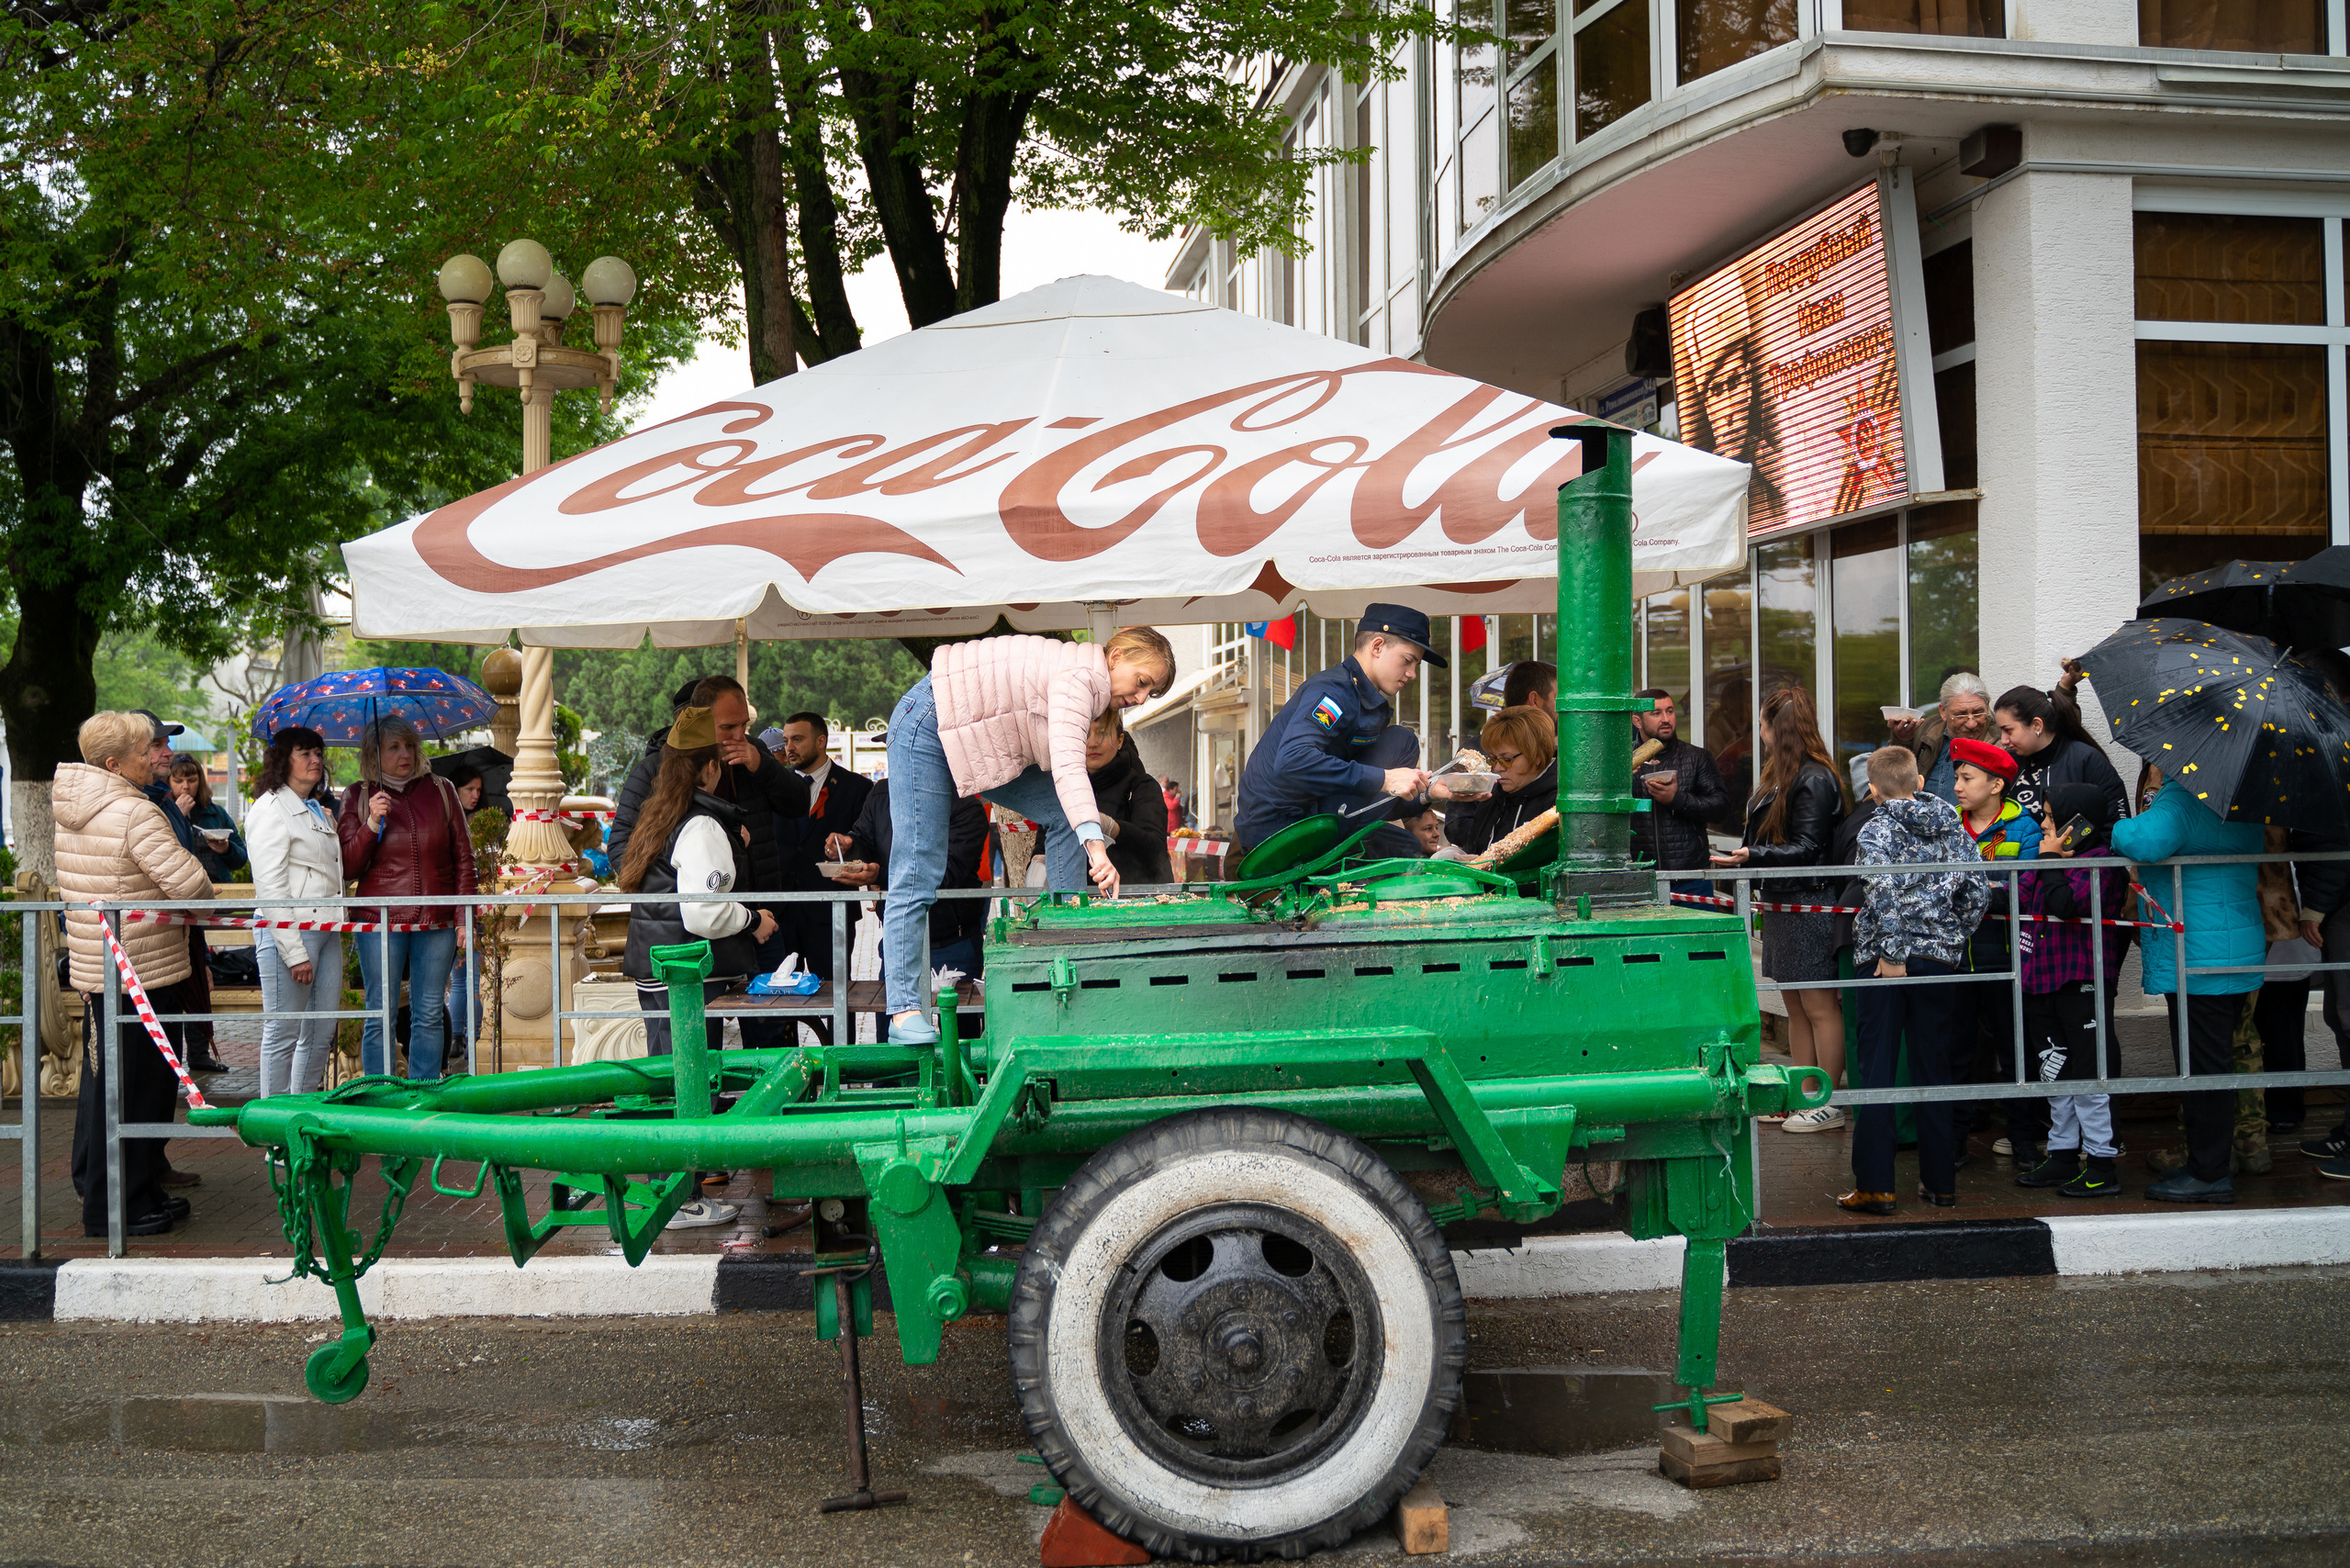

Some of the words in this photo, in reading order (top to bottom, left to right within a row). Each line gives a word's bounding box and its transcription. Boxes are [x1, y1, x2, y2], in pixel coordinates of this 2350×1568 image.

[1797, 291, 1845, 338] Иван
[412, 356, 1662, 594] Coca-Cola
[1308, 554, 1341, 564] Coca-Cola
[1342, 554, 1371, 563] является
[1372, 551, 1439, 561] зарегистрированным
[1440, 549, 1472, 557] товарным
[1497, 545, 1509, 554] The
[1510, 543, 1543, 553] Coca-Cola
[1649, 538, 1680, 546] Company.
[2117, 798, 2127, 819] WHI
